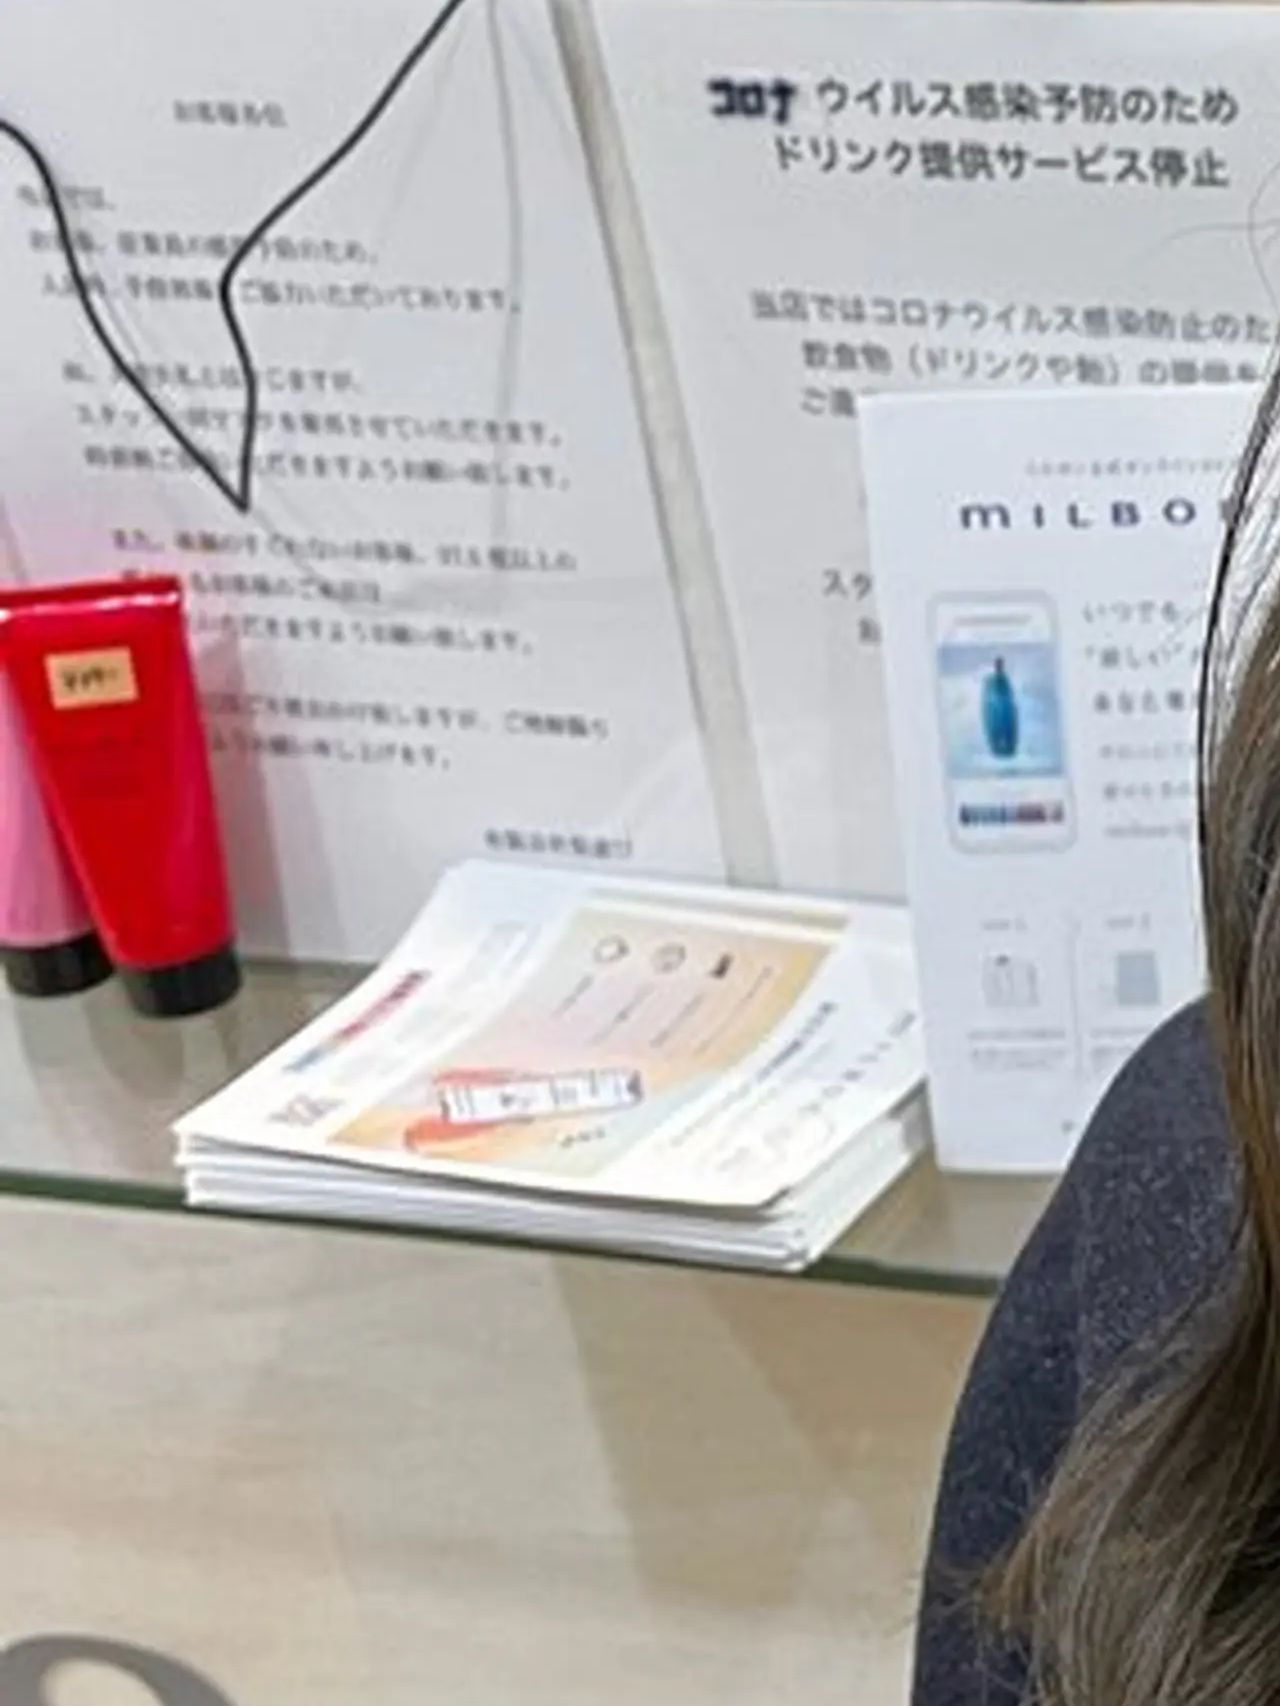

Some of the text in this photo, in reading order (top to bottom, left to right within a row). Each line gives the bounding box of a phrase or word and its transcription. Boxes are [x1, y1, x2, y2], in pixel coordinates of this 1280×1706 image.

[708, 79, 1239, 126] コロナ ウイルス感染予防のため
[775, 135, 1231, 188] ドリンク提供サービス停止
